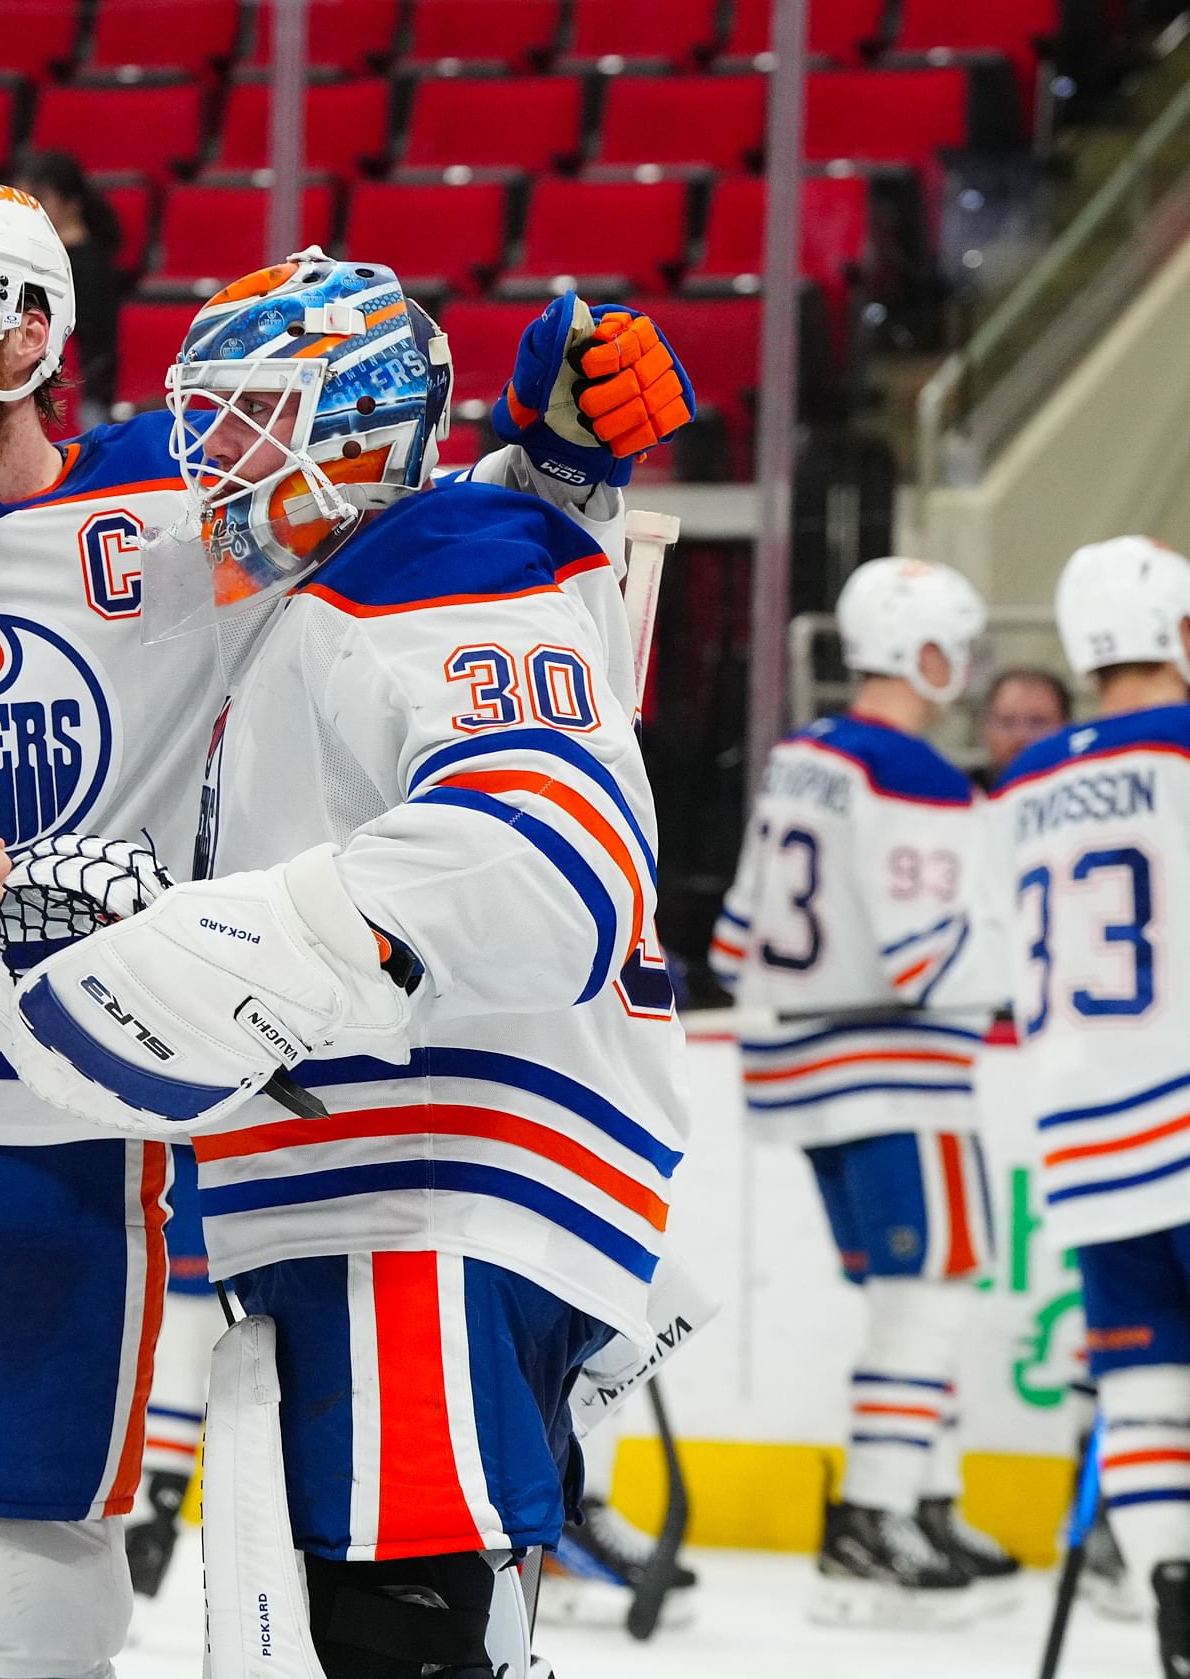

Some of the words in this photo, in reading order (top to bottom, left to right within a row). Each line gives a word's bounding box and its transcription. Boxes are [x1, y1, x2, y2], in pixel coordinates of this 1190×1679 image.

[539, 460, 586, 484] CCM
[77, 508, 144, 621] C
[444, 643, 601, 733] 30
[199, 917, 261, 944] PICKARD
[761, 824, 826, 972] 3
[1016, 844, 1159, 1038] 33
[80, 975, 175, 1061] SLR3
[247, 1011, 299, 1062] VAUGHN
[258, 1593, 272, 1657] PICKARD
